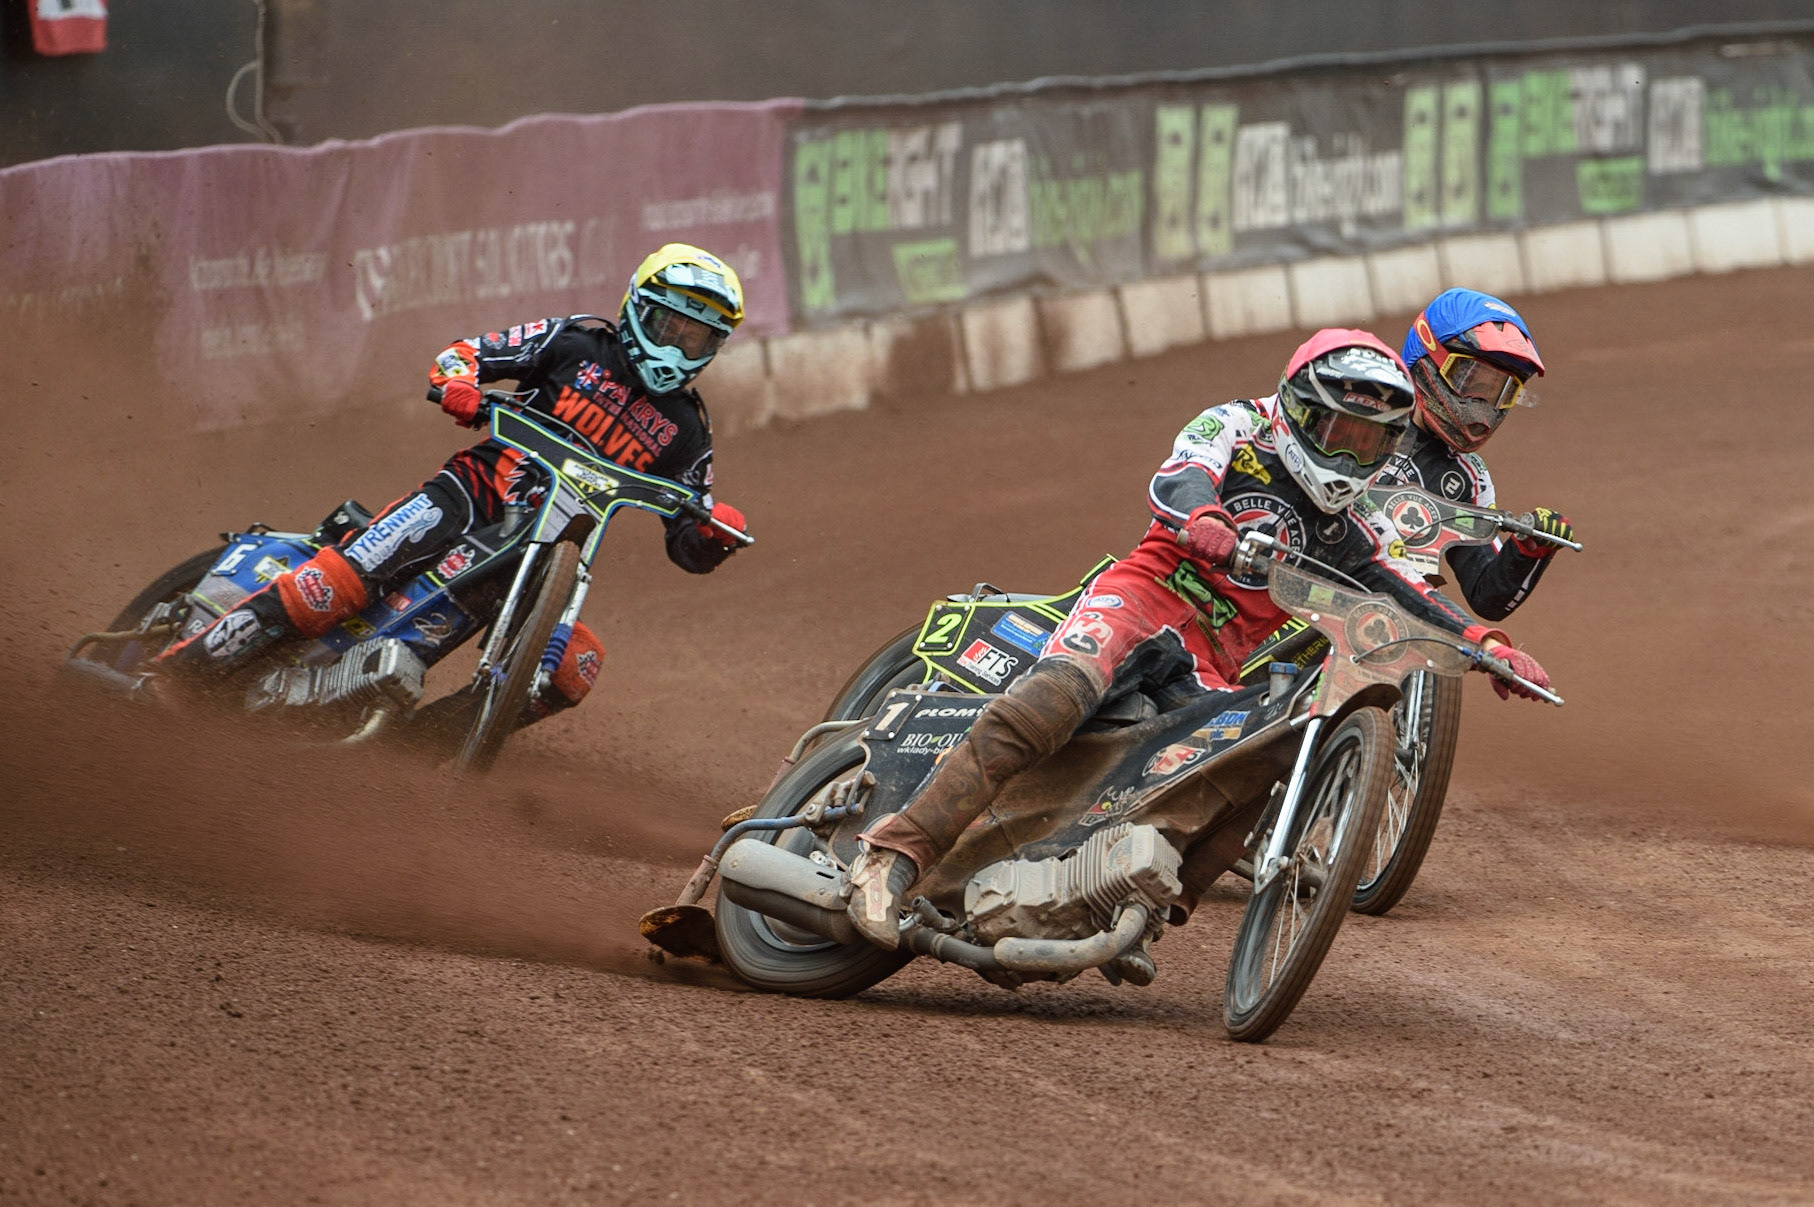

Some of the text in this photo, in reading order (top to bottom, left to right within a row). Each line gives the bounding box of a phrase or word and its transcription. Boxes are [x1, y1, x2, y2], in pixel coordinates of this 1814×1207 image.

[1233, 497, 1272, 513] BELLE
[924, 612, 963, 644] 2
[977, 648, 1018, 677] FTS
[874, 701, 910, 731] 1
